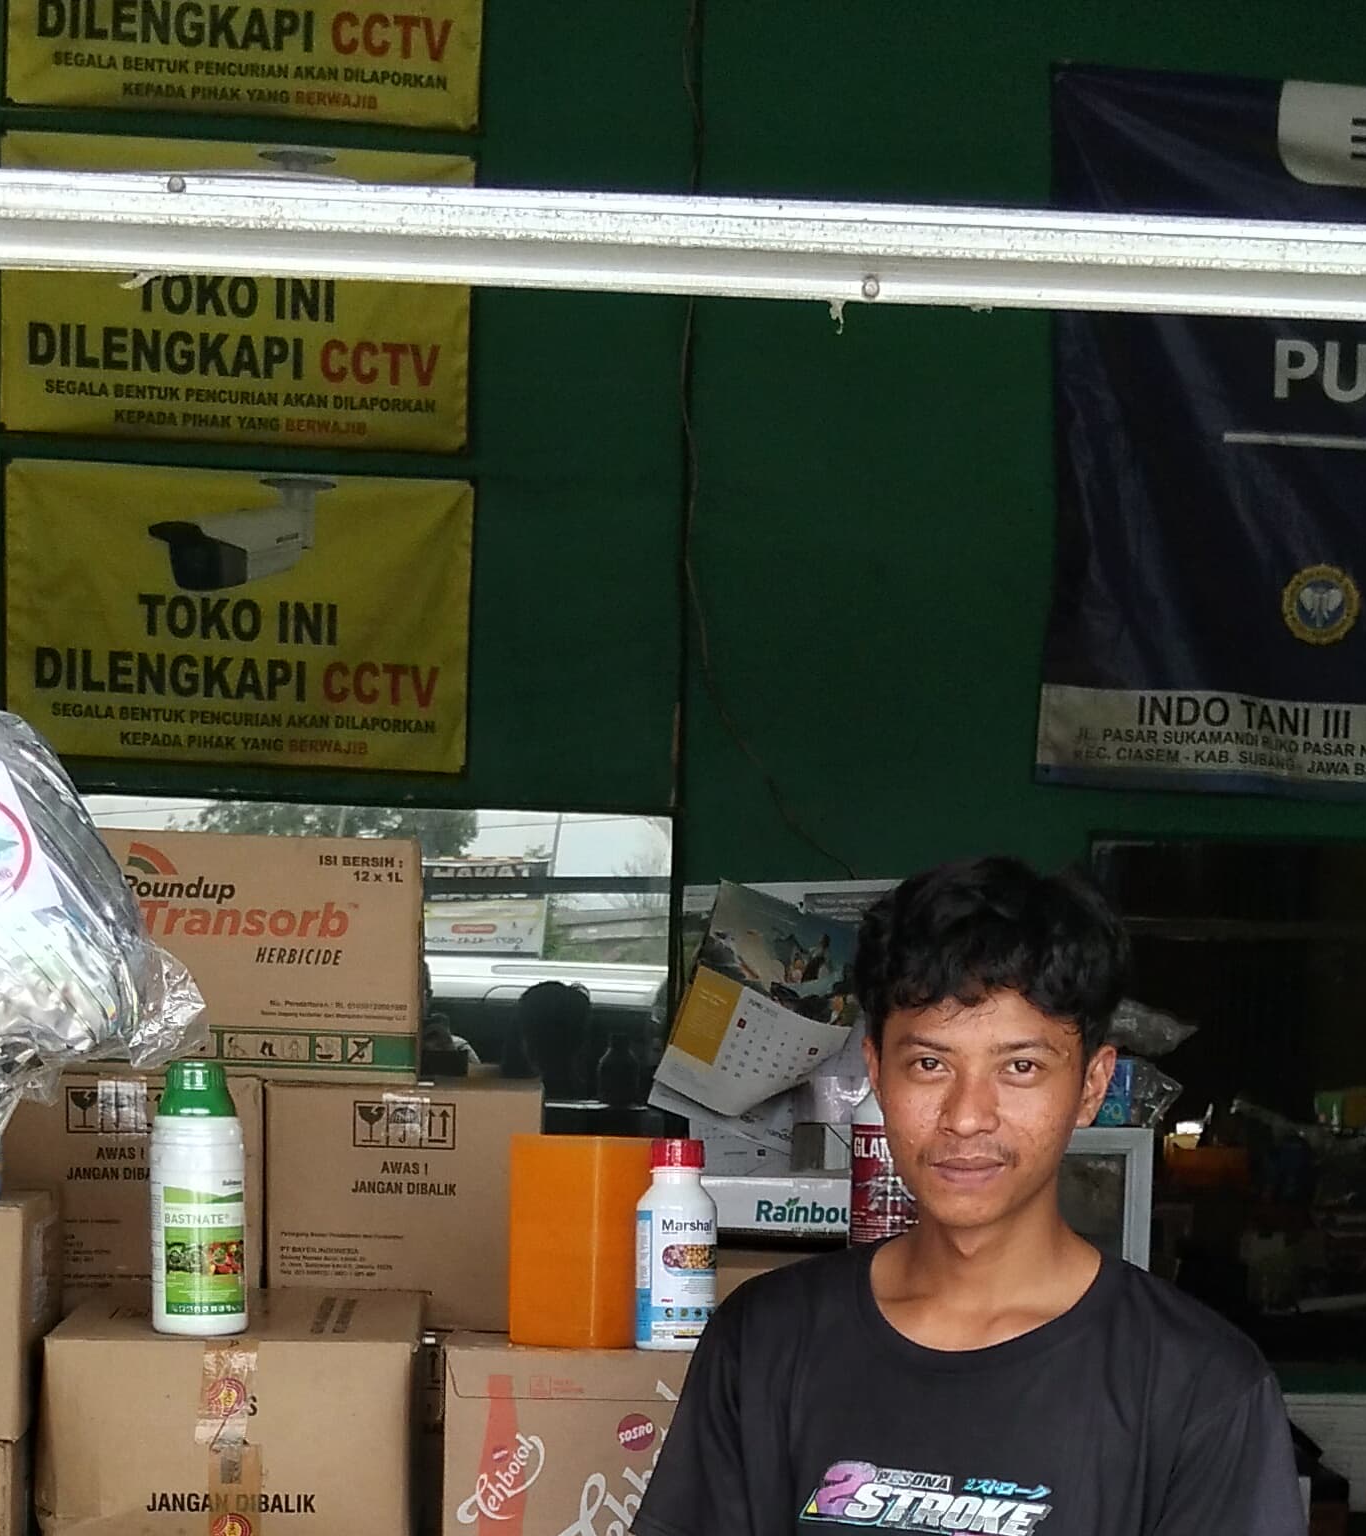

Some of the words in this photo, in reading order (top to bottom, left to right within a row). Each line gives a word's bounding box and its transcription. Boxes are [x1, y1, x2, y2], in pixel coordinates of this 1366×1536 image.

[35, 0, 315, 54] DILENGKAPI
[331, 12, 455, 62] CCTV
[53, 51, 118, 71] SEGALA
[122, 57, 189, 76] BENTUK
[194, 60, 289, 80] PENCURIAN
[294, 65, 340, 83] AKAN
[343, 68, 447, 91] DILAPORKAN
[122, 81, 186, 99] KEPADA
[191, 85, 240, 103] PIHAK
[247, 88, 291, 105] YANG
[295, 91, 379, 111] BERWAJIB
[138, 275, 259, 320] TOKO
[274, 278, 336, 324] INI
[26, 321, 305, 382] DILENGKAPI
[319, 338, 441, 390] CCTV
[44, 378, 110, 399] SEGALA
[114, 382, 182, 404] BENTUK
[185, 386, 280, 408] PENCURIAN
[283, 391, 329, 411] AKAN
[332, 393, 437, 415] DILAPORKAN
[114, 408, 180, 428] KEPADA
[183, 412, 232, 431] PIHAK
[238, 415, 281, 433] YANG
[285, 417, 369, 437] BERWAJIB
[138, 592, 261, 642] TOKO
[277, 601, 338, 647] INI
[35, 646, 308, 703] DILENGKAPI
[322, 660, 441, 712] CCTV
[51, 701, 116, 722] SEGALA
[119, 706, 186, 726] BENTUK
[189, 709, 282, 731] PENCURIAN
[286, 713, 331, 732] AKAN
[335, 715, 436, 736] DILAPORKAN
[1137, 694, 1230, 728] INDO
[1240, 700, 1311, 739] TANI
[1322, 709, 1352, 740] III
[120, 731, 184, 751] KEPADA
[187, 734, 236, 753] PIHAK
[241, 736, 285, 754] YANG
[289, 738, 369, 758] BERWAJIB
[1103, 728, 1158, 745] PASAR
[1163, 730, 1260, 749] SUKAMANDI
[1303, 741, 1355, 758] PASAR
[1116, 747, 1180, 764] CIASEM
[1306, 759, 1351, 777] JAWA
[318, 854, 339, 868] ISI
[341, 855, 393, 869] BERSIH
[351, 869, 370, 883] 12
[386, 870, 404, 884] 1L
[141, 900, 350, 939] Transorb
[255, 945, 343, 967] HERBICIDE
[96, 1147, 136, 1161] AWAS
[381, 1160, 419, 1176] AWAS
[66, 1166, 115, 1182] JANGAN
[351, 1180, 403, 1196] JANGAN
[406, 1182, 457, 1197] DIBALIK
[164, 1212, 226, 1225] BASTNATE
[616, 1420, 655, 1444] SOSRO
[146, 1492, 229, 1513] JANGAN
[235, 1493, 316, 1514] DIBALIK
